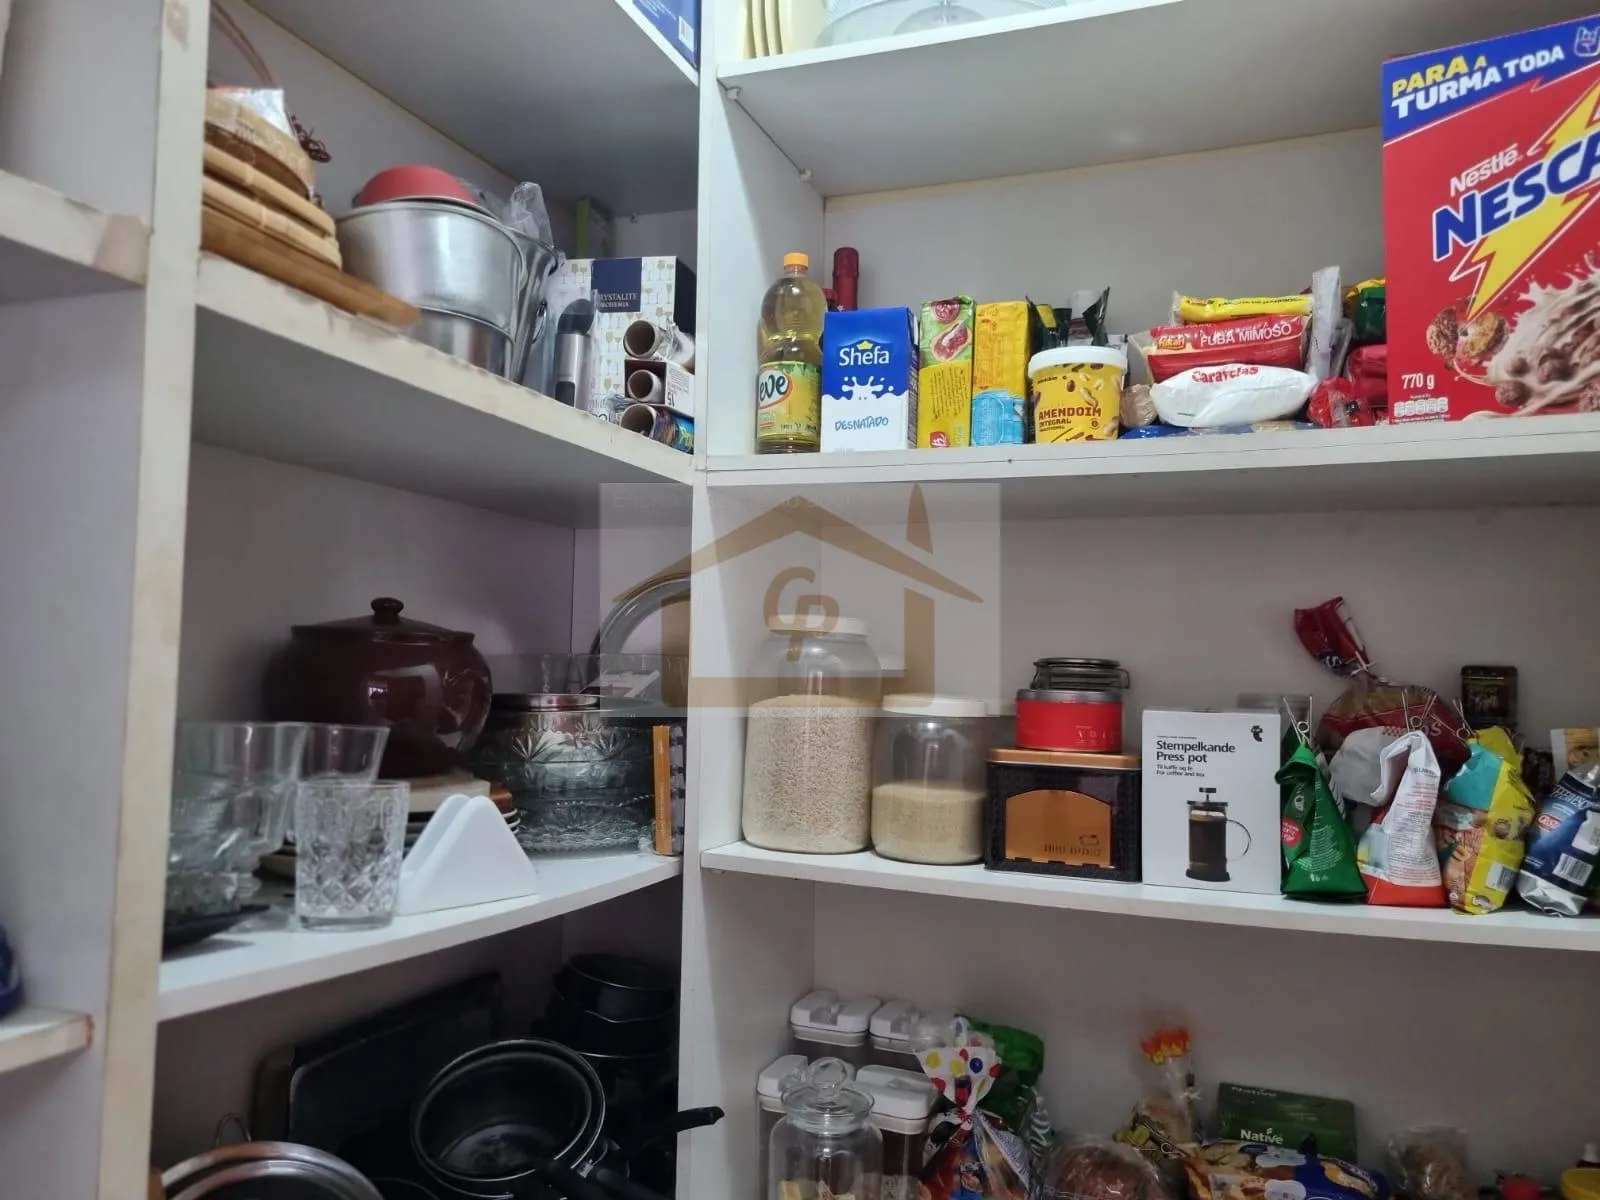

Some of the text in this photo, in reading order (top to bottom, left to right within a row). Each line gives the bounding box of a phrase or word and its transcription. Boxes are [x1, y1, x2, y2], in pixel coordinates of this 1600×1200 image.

[1391, 45, 1565, 119] TURMA TODA
[1392, 55, 1488, 98] PARA A
[1239, 323, 1292, 342] MIMOSO
[839, 346, 890, 366] Shefa
[1401, 372, 1435, 390] 770 g
[1038, 407, 1102, 420] AMENDOIM
[834, 415, 889, 432] DESNATADO
[1156, 740, 1236, 753] Stempelkande
[1156, 751, 1208, 764] Press pot
[1241, 1129, 1284, 1145] Native
